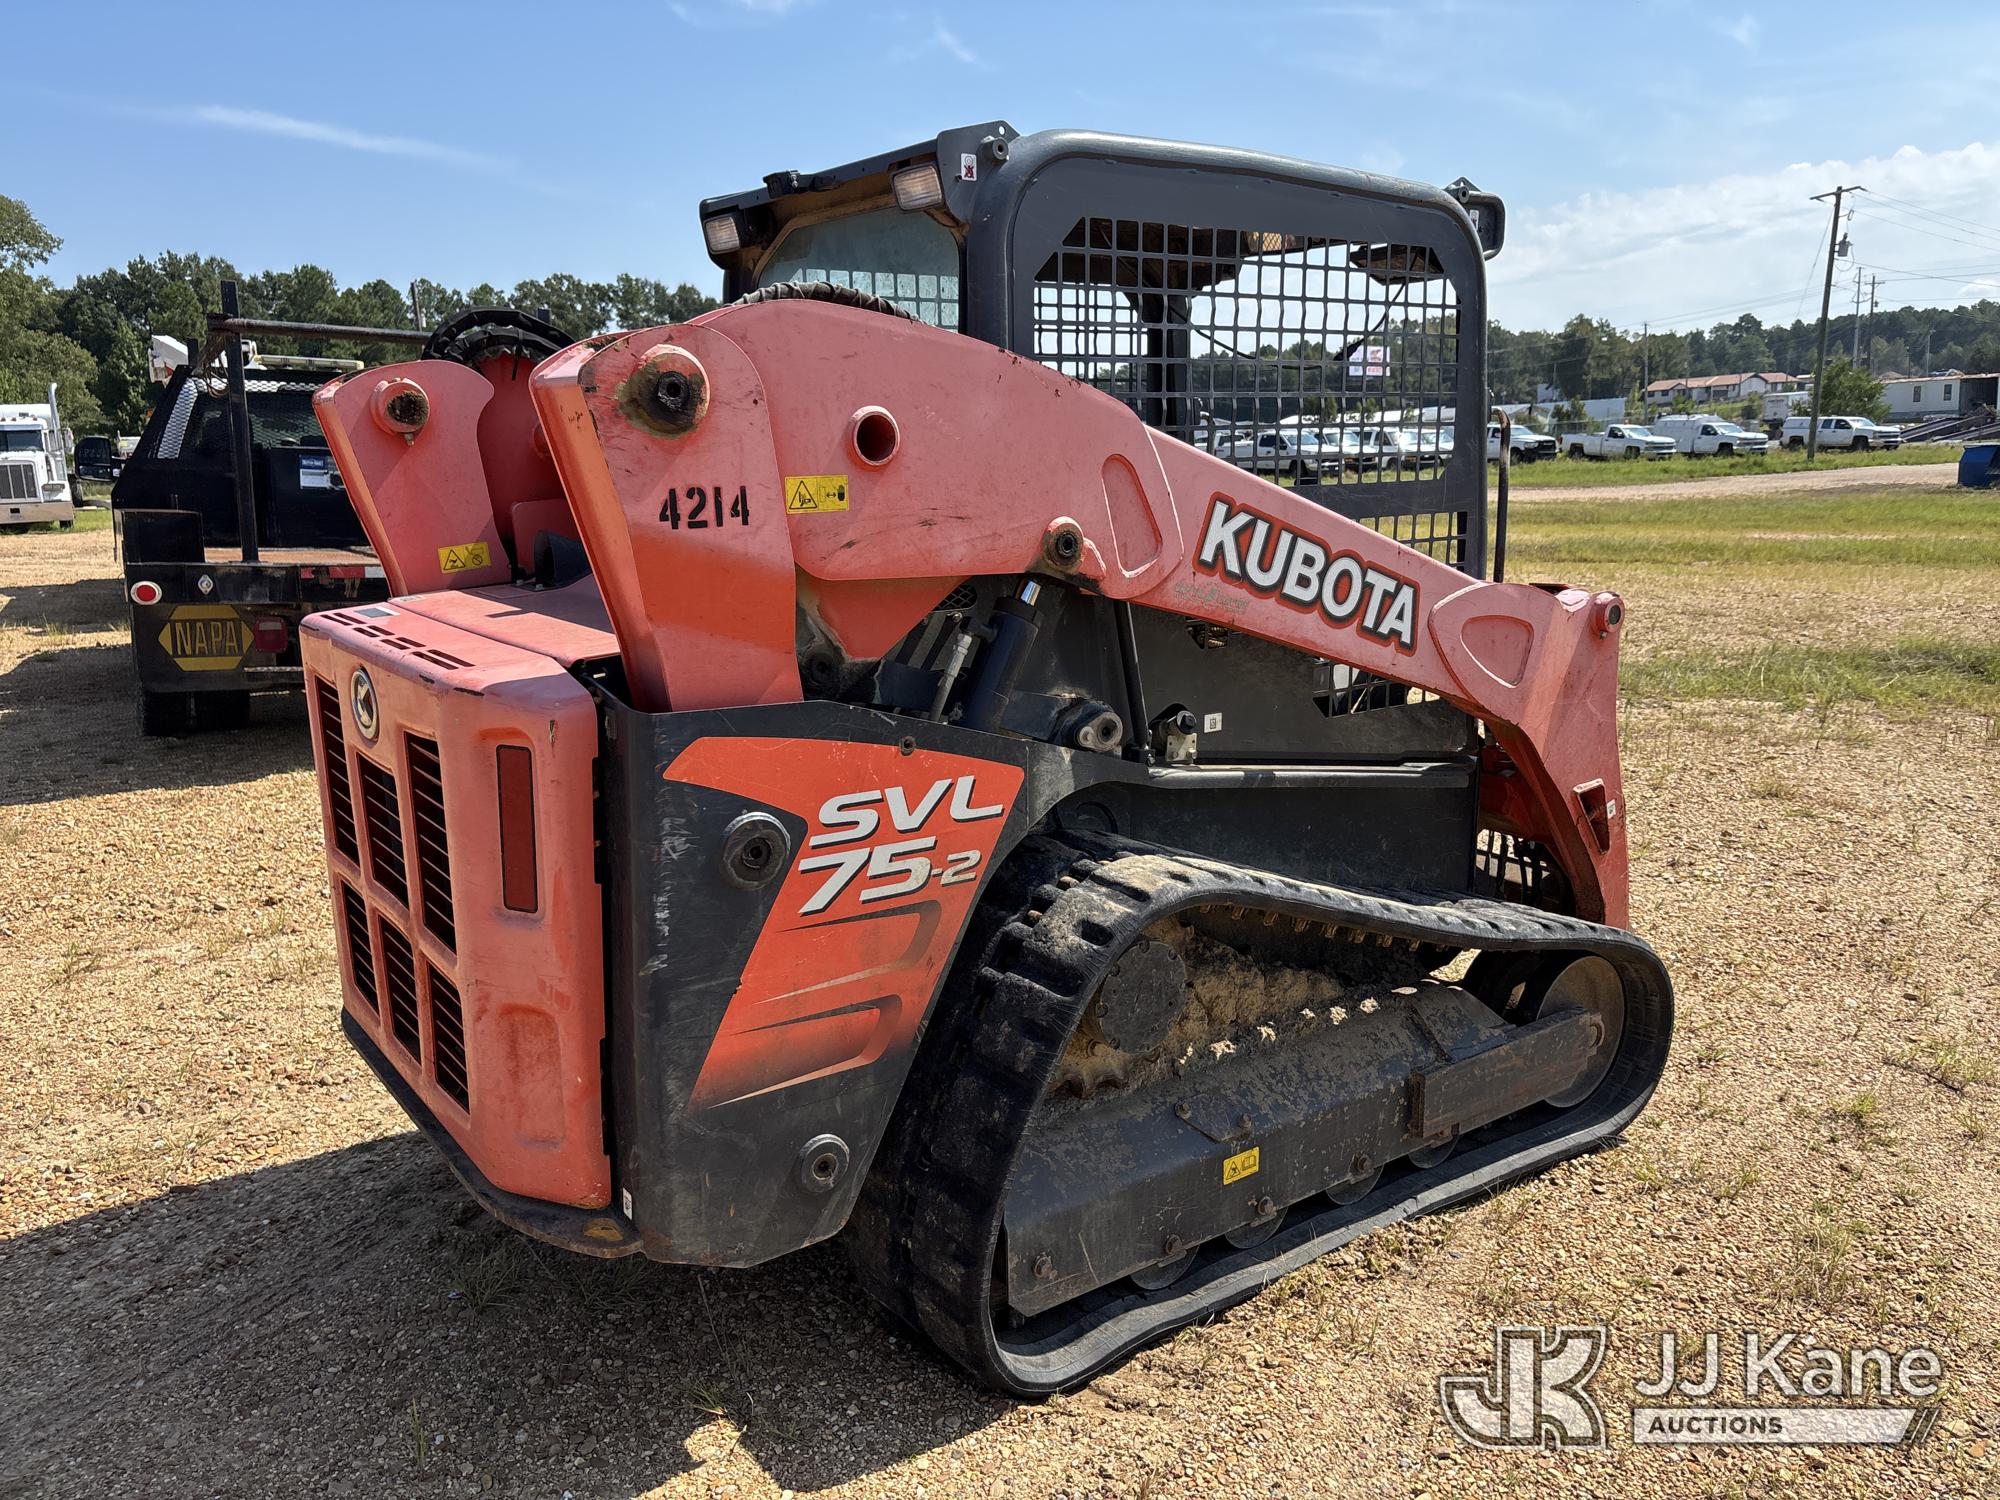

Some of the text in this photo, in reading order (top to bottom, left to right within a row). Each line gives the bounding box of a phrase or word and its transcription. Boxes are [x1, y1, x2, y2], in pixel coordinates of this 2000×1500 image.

[659, 486, 749, 530] 4214
[1200, 500, 1416, 646] KUBOTA
[175, 621, 239, 655] NAPA
[809, 775, 1003, 848] SVL
[798, 836, 982, 916] 75-2
